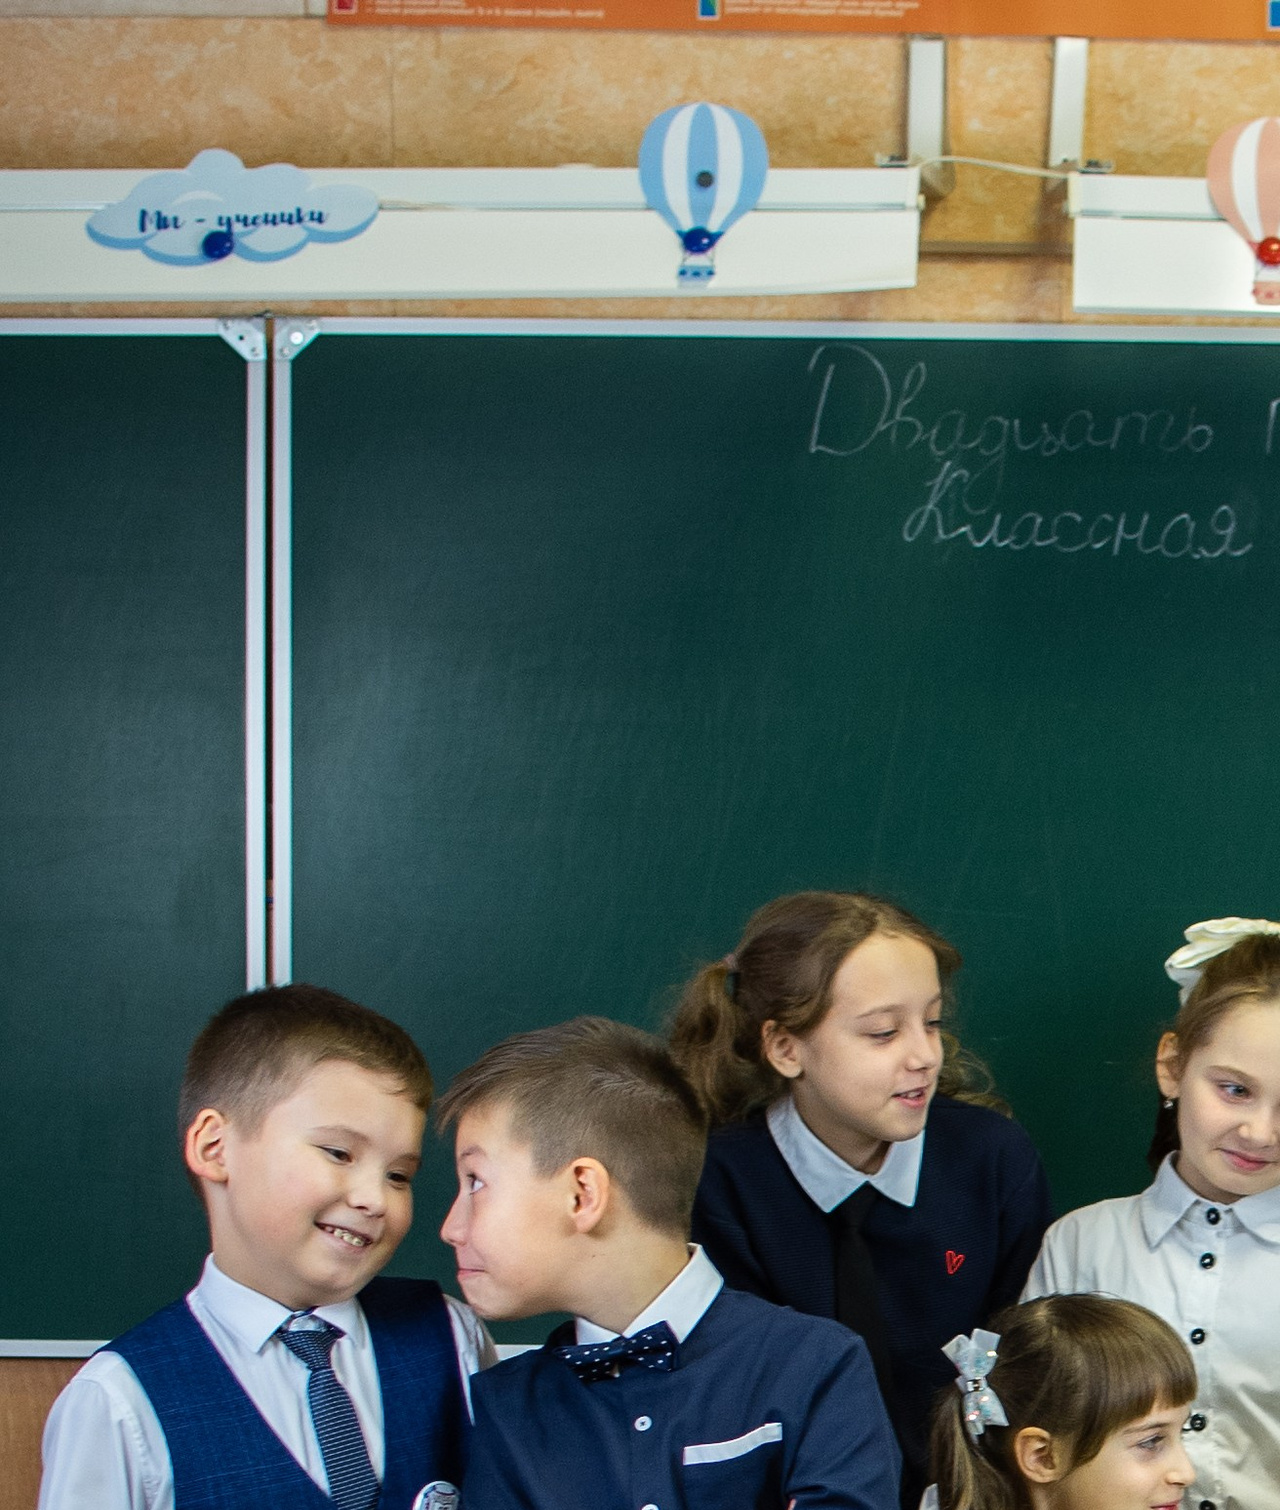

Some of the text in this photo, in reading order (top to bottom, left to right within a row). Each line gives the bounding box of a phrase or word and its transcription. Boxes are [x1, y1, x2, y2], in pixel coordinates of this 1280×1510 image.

[137, 208, 184, 233] Мы
[216, 206, 326, 234] ученики
[808, 343, 1215, 515] Двадцать
[903, 460, 1253, 559] Классная
